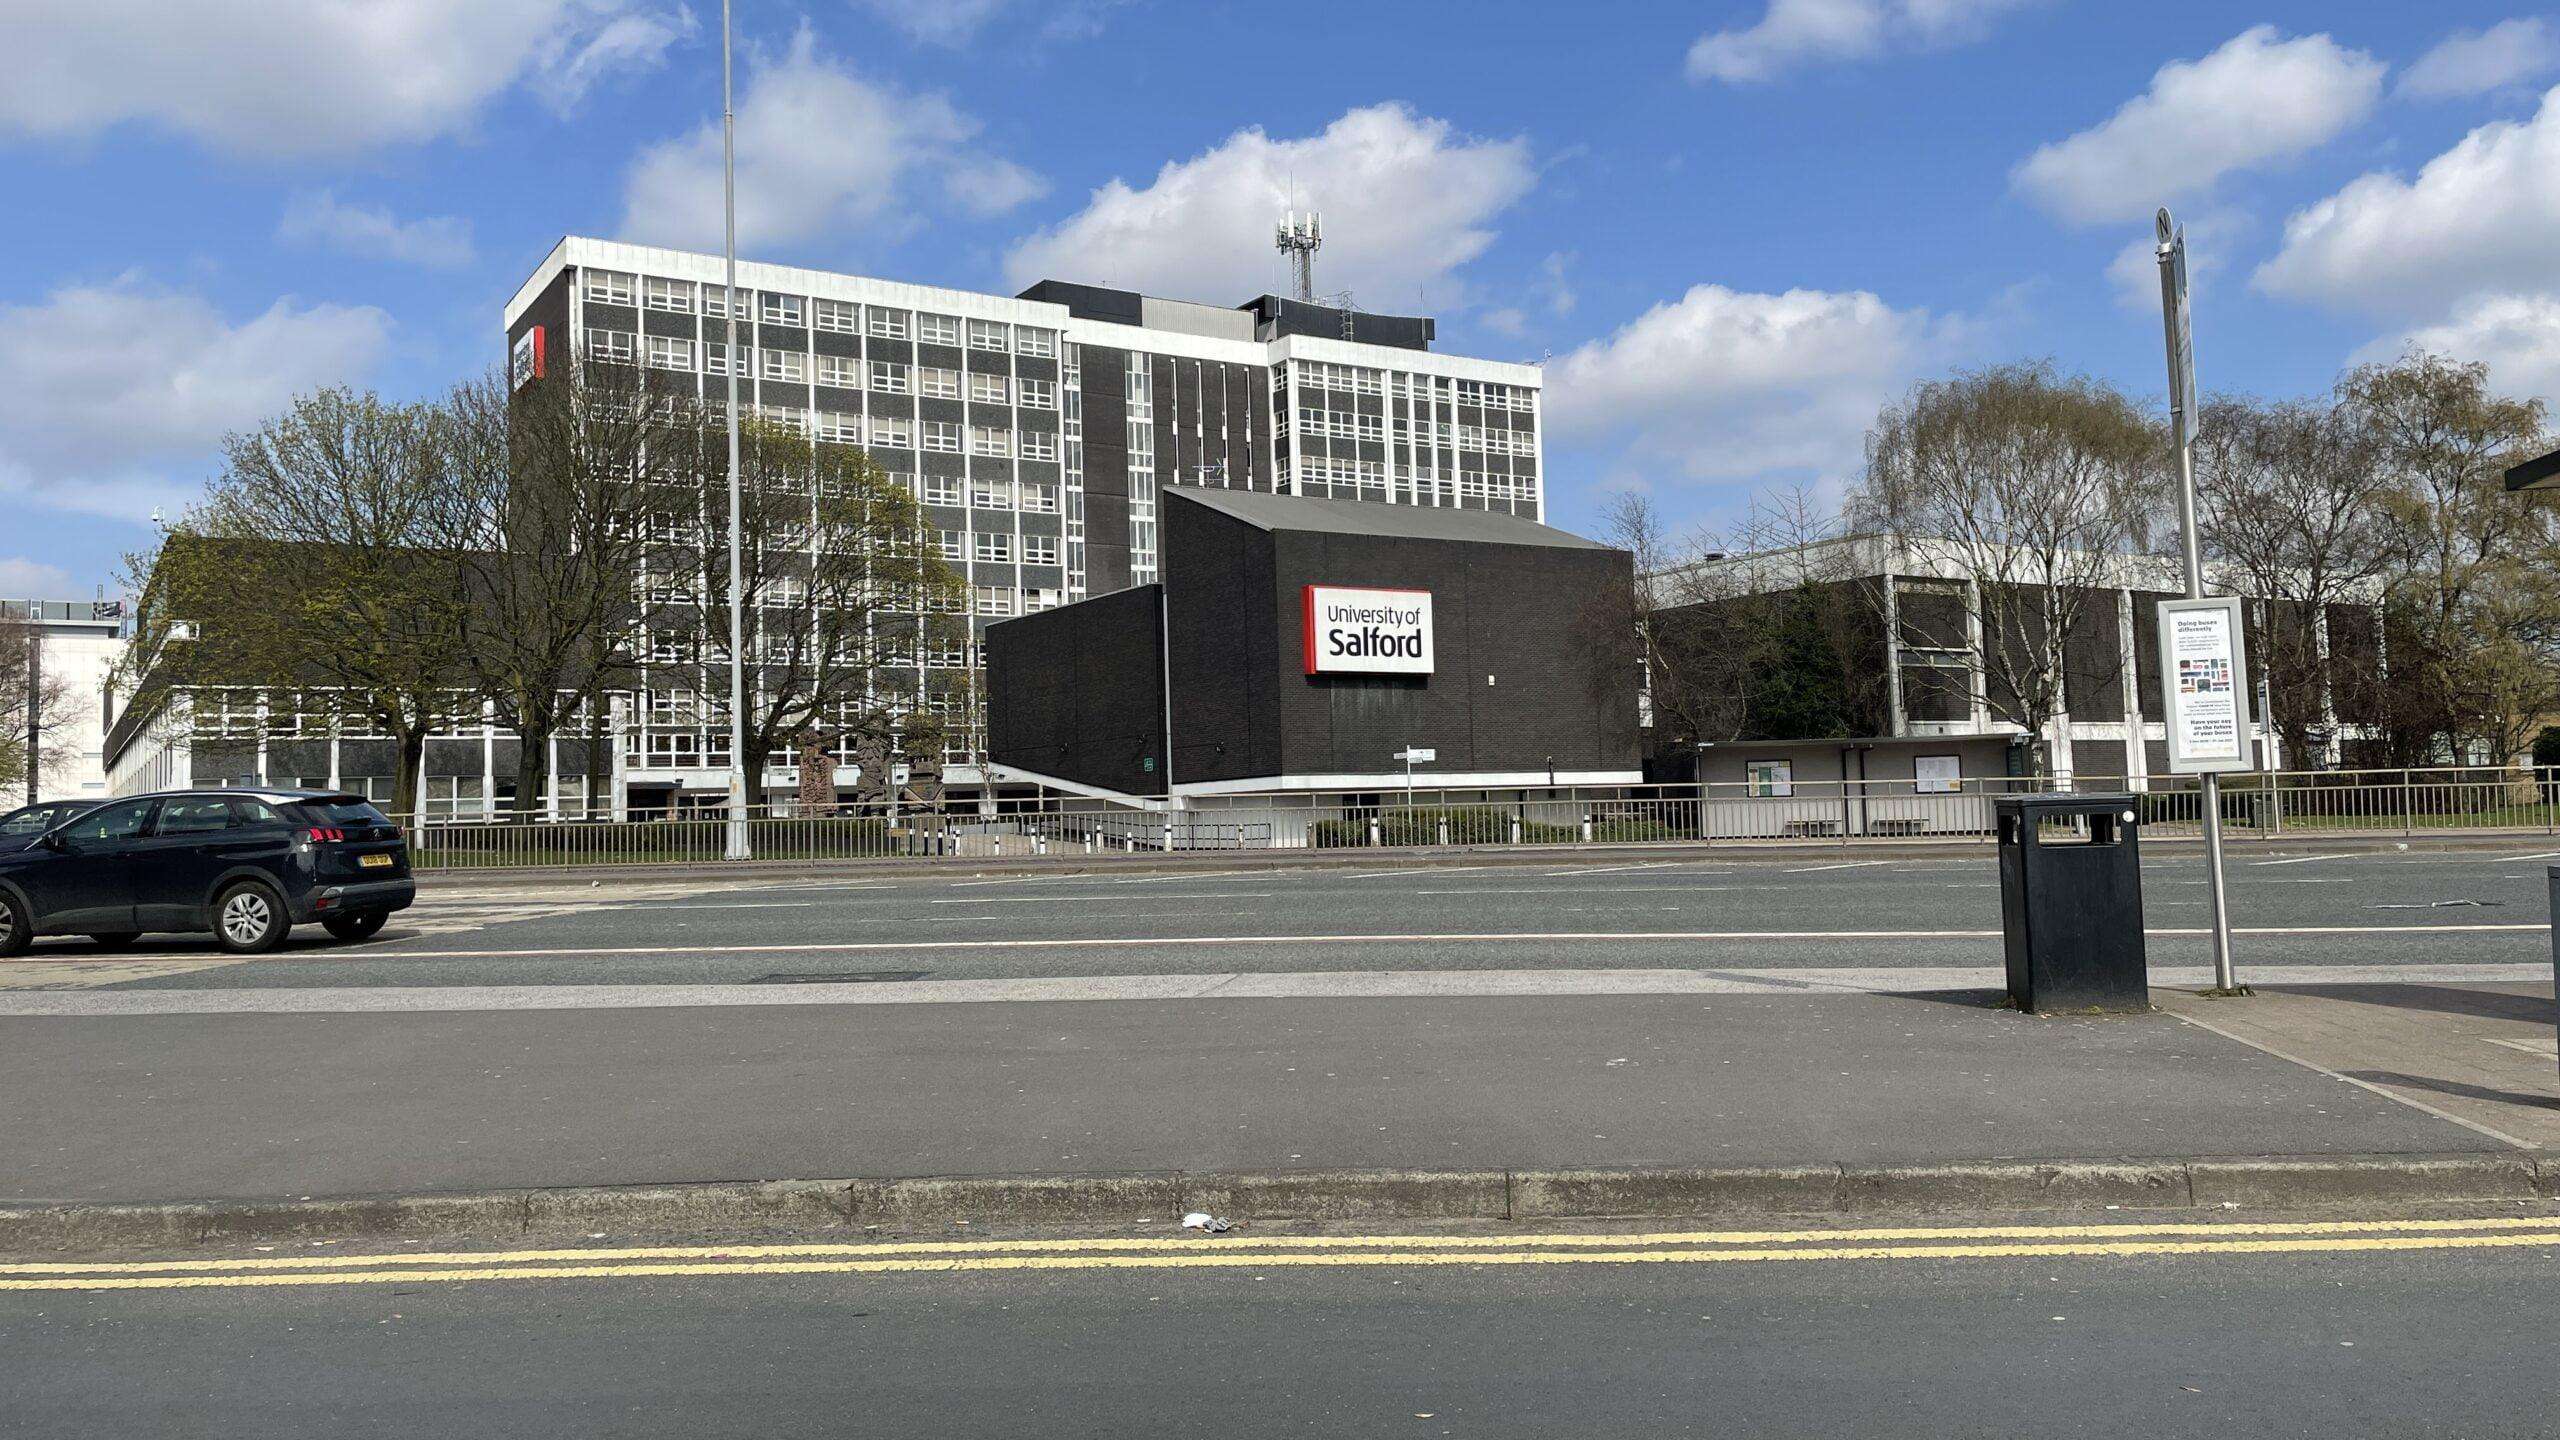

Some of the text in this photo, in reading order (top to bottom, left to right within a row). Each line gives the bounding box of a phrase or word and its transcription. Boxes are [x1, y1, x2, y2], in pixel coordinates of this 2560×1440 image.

[2158, 212, 2169, 238] N
[1328, 605, 1421, 629] University of
[1328, 626, 1422, 658] Salford
